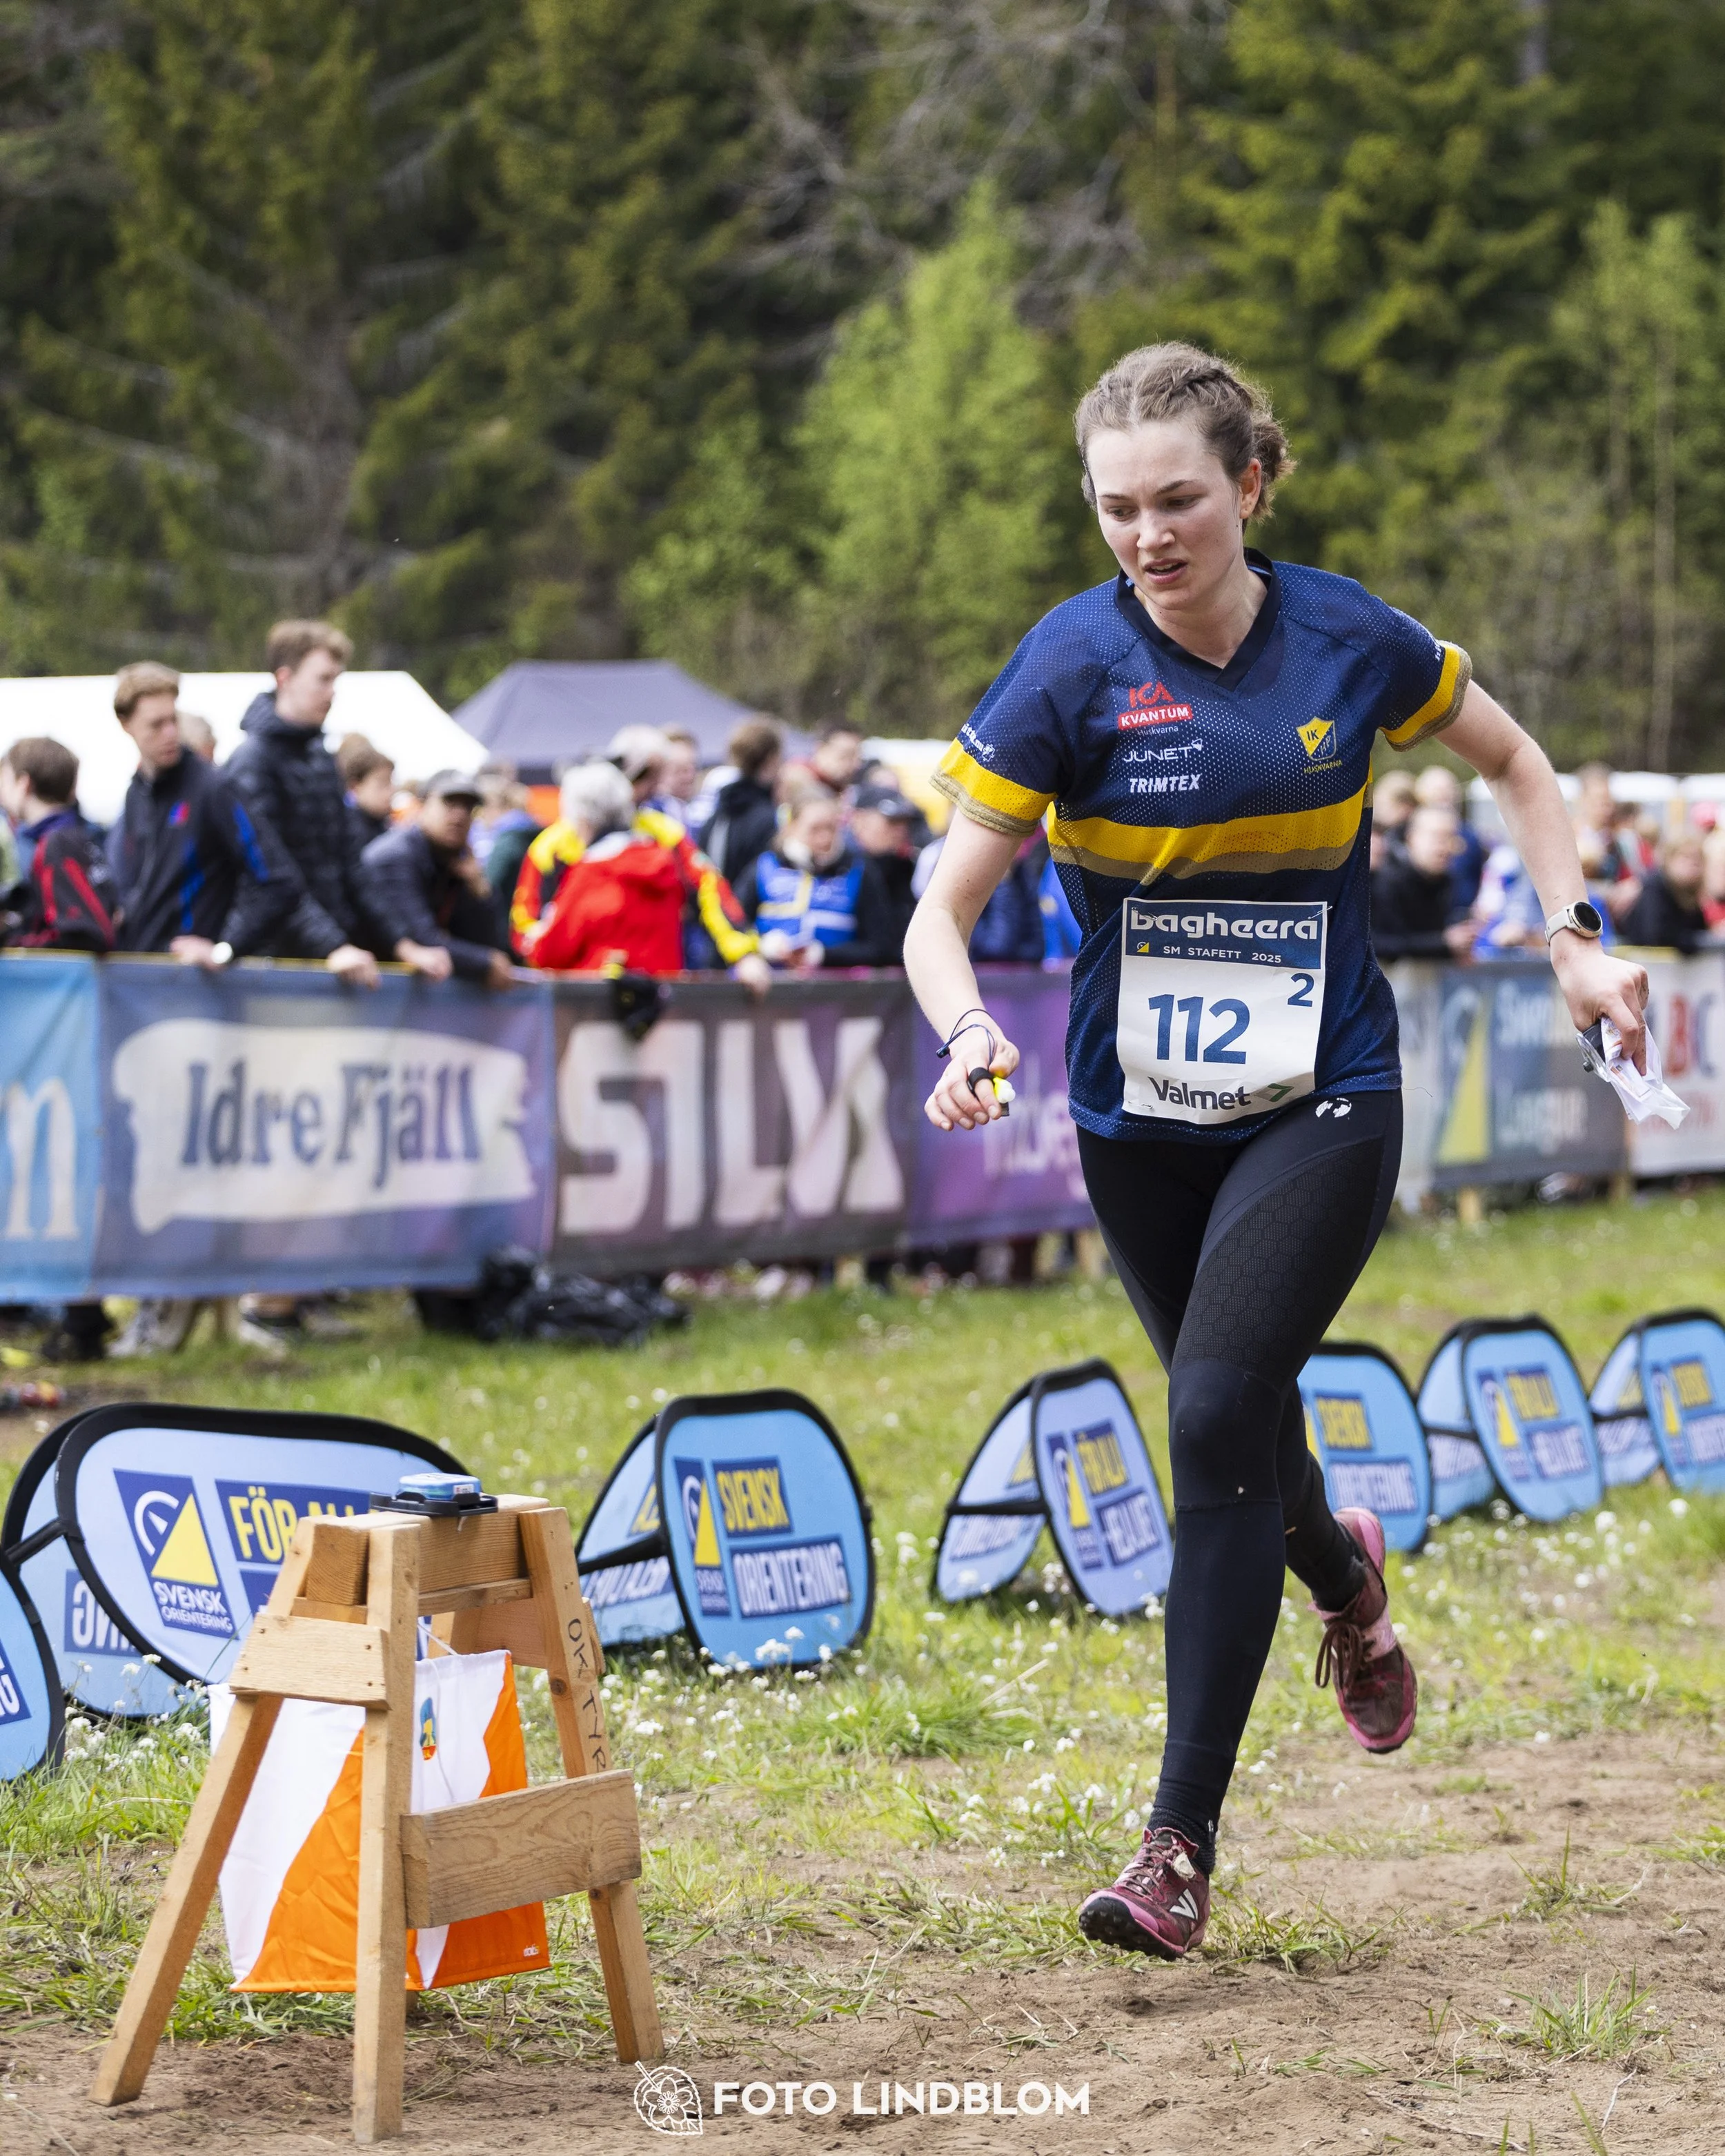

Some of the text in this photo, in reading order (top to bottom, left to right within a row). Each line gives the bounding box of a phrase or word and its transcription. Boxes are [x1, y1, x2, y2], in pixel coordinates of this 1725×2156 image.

[1129, 680, 1174, 708] ICA
[1121, 707, 1190, 726] KVANTUM
[1137, 726, 1179, 736] Huskvarna
[1306, 729, 1319, 741] IK
[1123, 746, 1193, 762] JUNET
[1303, 760, 1343, 773] HUSKVARNA
[1130, 773, 1201, 793] TRIMTEX
[1131, 907, 1318, 940] bagheera
[1163, 946, 1281, 963] SM STAFETT 2025
[1287, 972, 1314, 1007] 2
[1148, 994, 1250, 1065] 112
[1147, 1076, 1252, 1110] Valmet
[716, 1467, 790, 1532] SVENSK
[153, 1581, 228, 1615] SVENSK
[161, 1605, 233, 1633] ORIENTERING
[568, 1618, 588, 1678] OK
